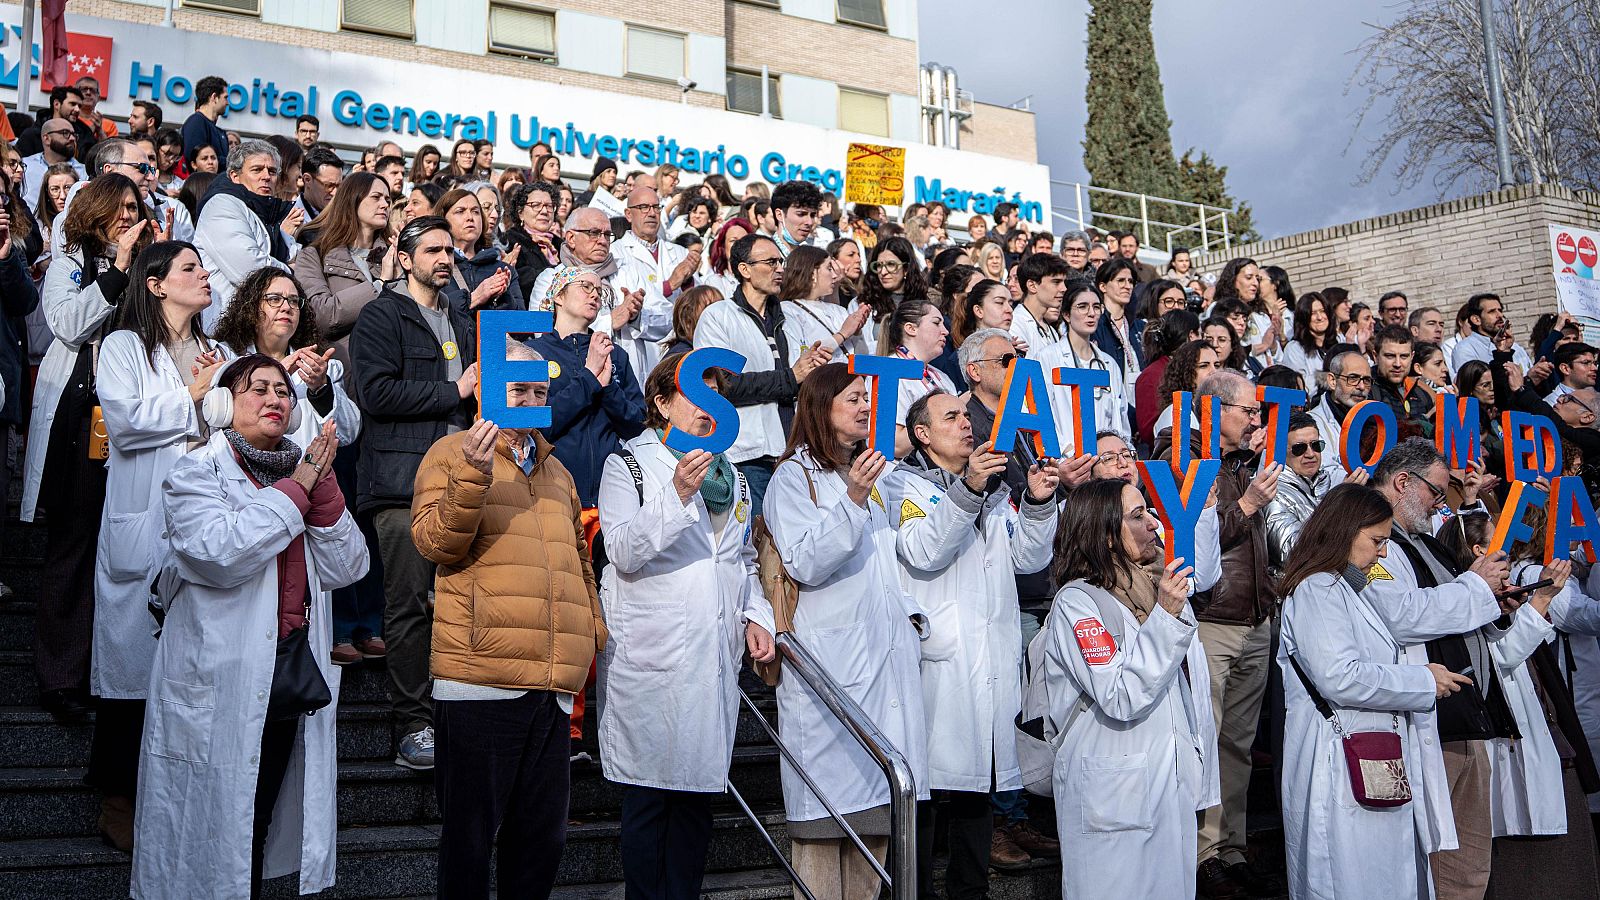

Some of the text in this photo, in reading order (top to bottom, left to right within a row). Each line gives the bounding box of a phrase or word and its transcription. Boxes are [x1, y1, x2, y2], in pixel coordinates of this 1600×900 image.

[129, 61, 319, 119] Hopital
[332, 90, 496, 147] General
[510, 114, 749, 179] Universitario
[760, 152, 844, 198] Greg
[623, 455, 643, 485] BIMBA
[1145, 459, 1221, 577] Y
[1076, 627, 1106, 638] STOP
[1082, 646, 1111, 654] GUARDIAS
